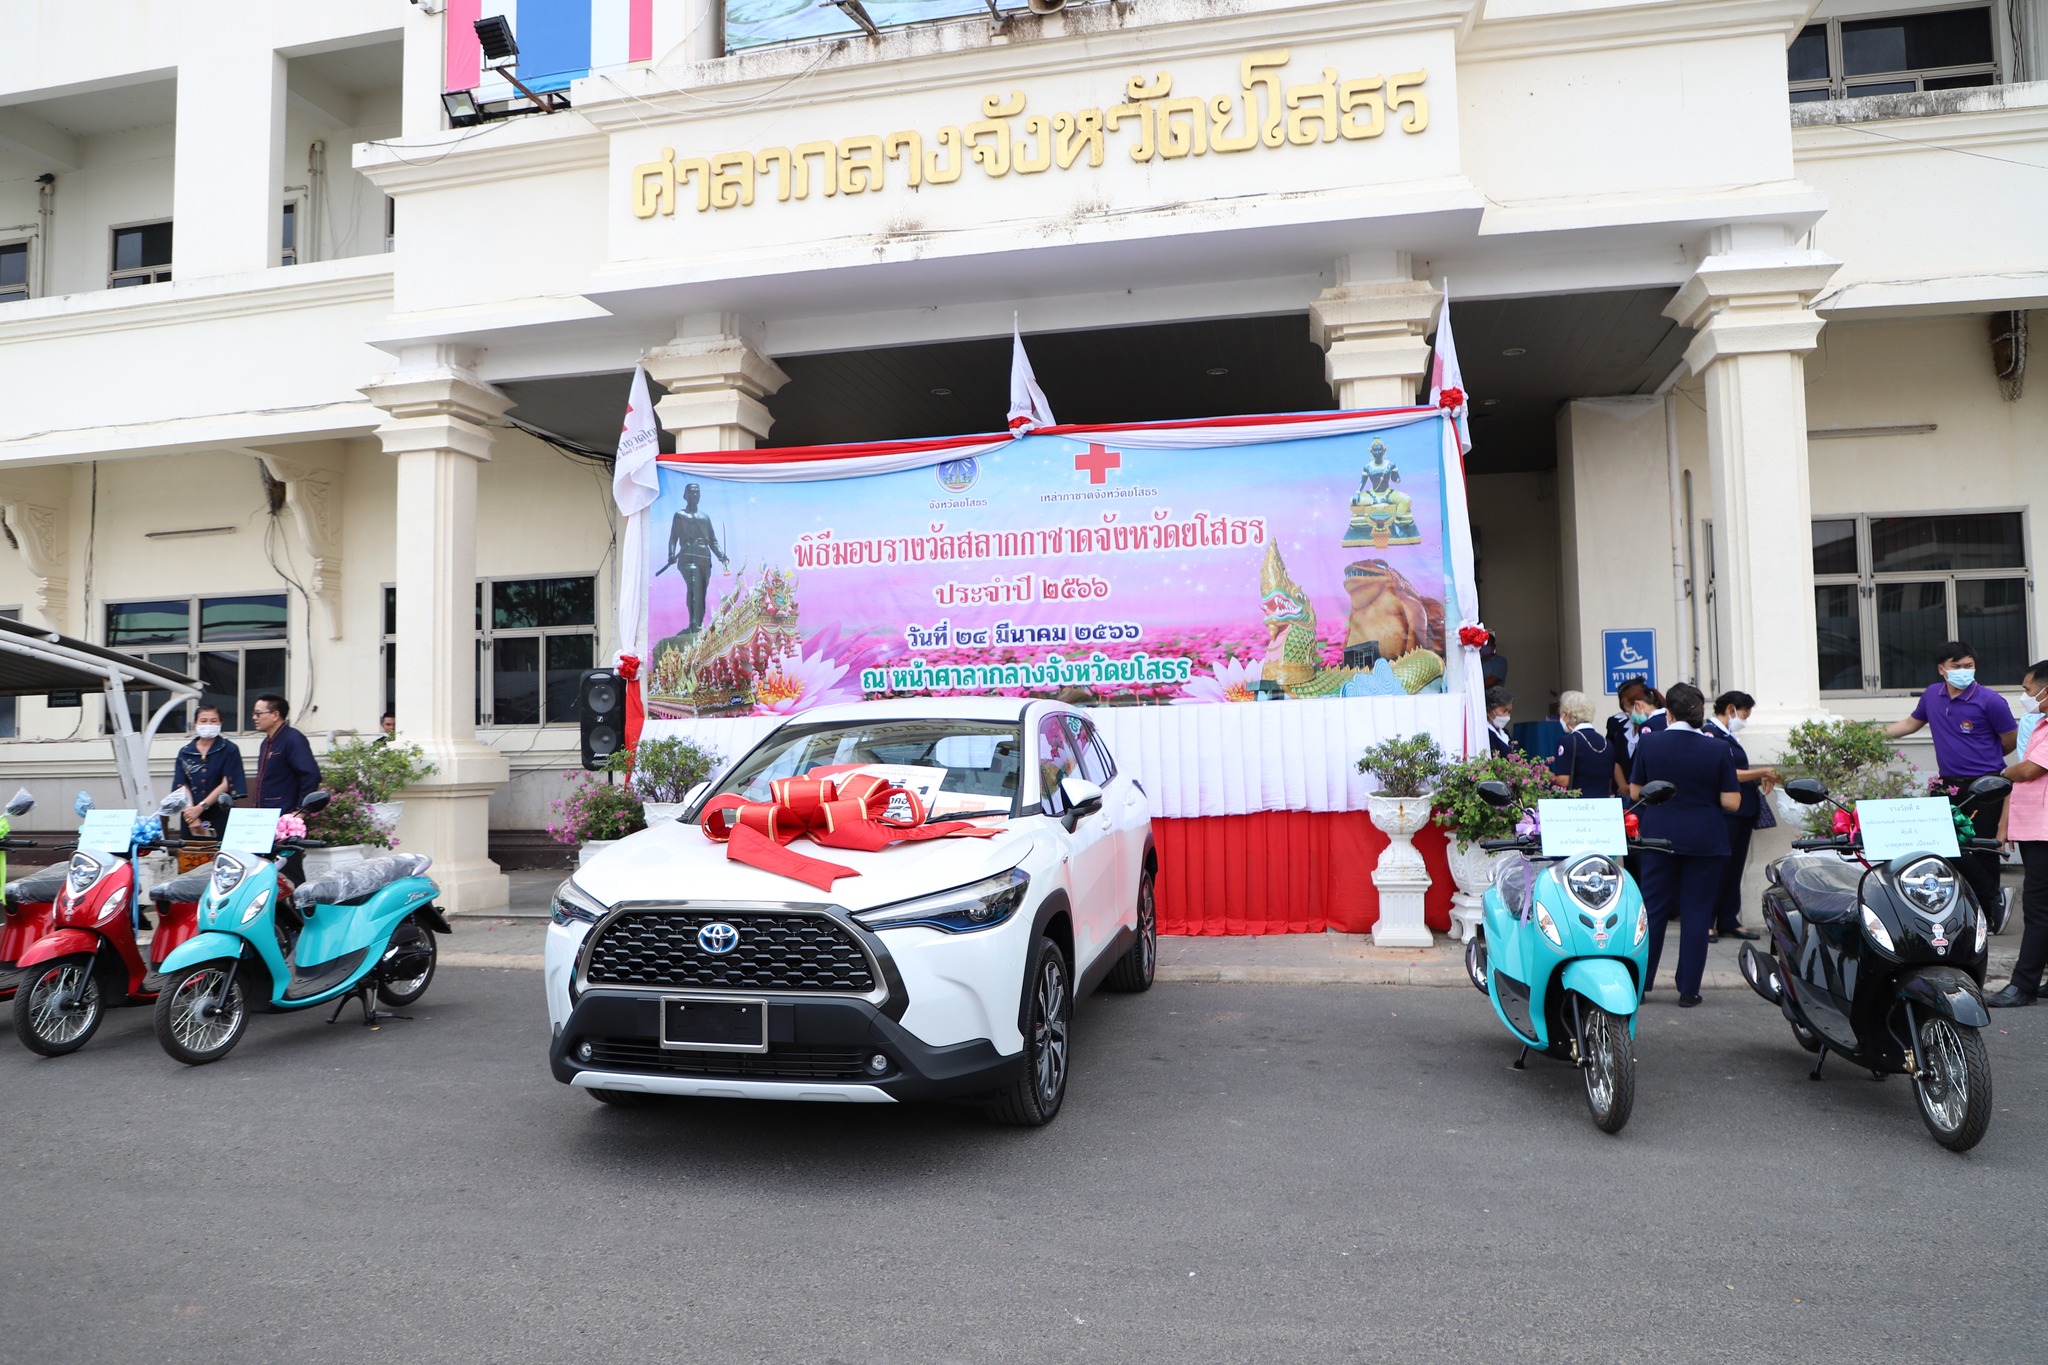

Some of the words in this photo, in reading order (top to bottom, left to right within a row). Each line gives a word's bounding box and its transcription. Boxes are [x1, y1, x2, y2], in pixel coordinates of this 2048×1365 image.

[631, 48, 1429, 219] ศาลากลางจังหวัดยโสธร
[929, 497, 988, 509] จังหวัดยโสธร
[1040, 487, 1158, 502] เหล่ากาชาดจังหวัดยโสธร
[794, 510, 1264, 567] พิธีมอบรางวัลสลากกาชาดจังหวัดยโสธร
[936, 574, 1031, 605] ประจำปี
[1042, 577, 1109, 600] ๒๕๖๖
[907, 621, 948, 647] วันที่
[956, 630, 988, 645] ๒๔
[995, 622, 1066, 644] มีนาคม
[1074, 624, 1140, 640] ๒๕๖๖
[863, 670, 886, 689] ณ
[892, 654, 1190, 688] หน้าศาลากลางจังหวัดยโสธร
